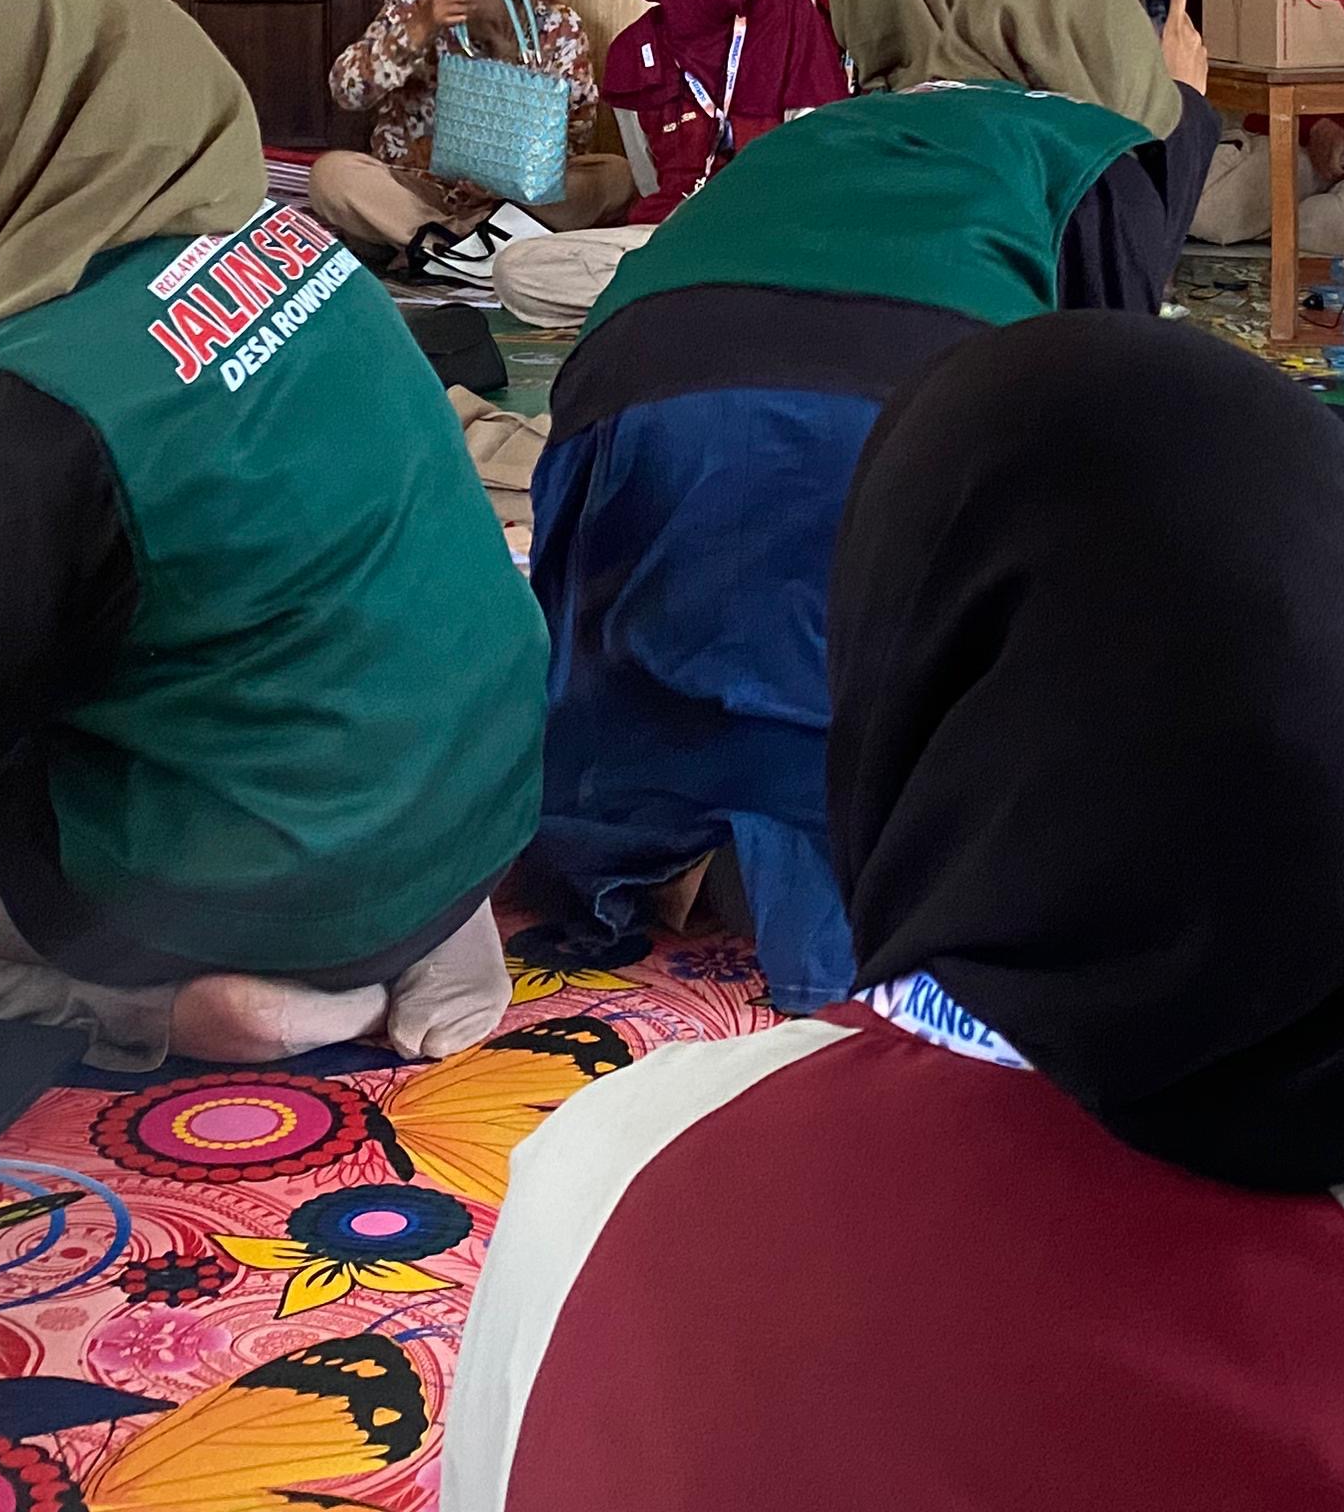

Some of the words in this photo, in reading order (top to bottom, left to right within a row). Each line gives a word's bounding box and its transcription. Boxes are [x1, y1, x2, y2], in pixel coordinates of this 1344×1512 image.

[155, 238, 214, 296] RELAWAN
[147, 241, 287, 384] JALIN
[219, 325, 285, 392] DESA
